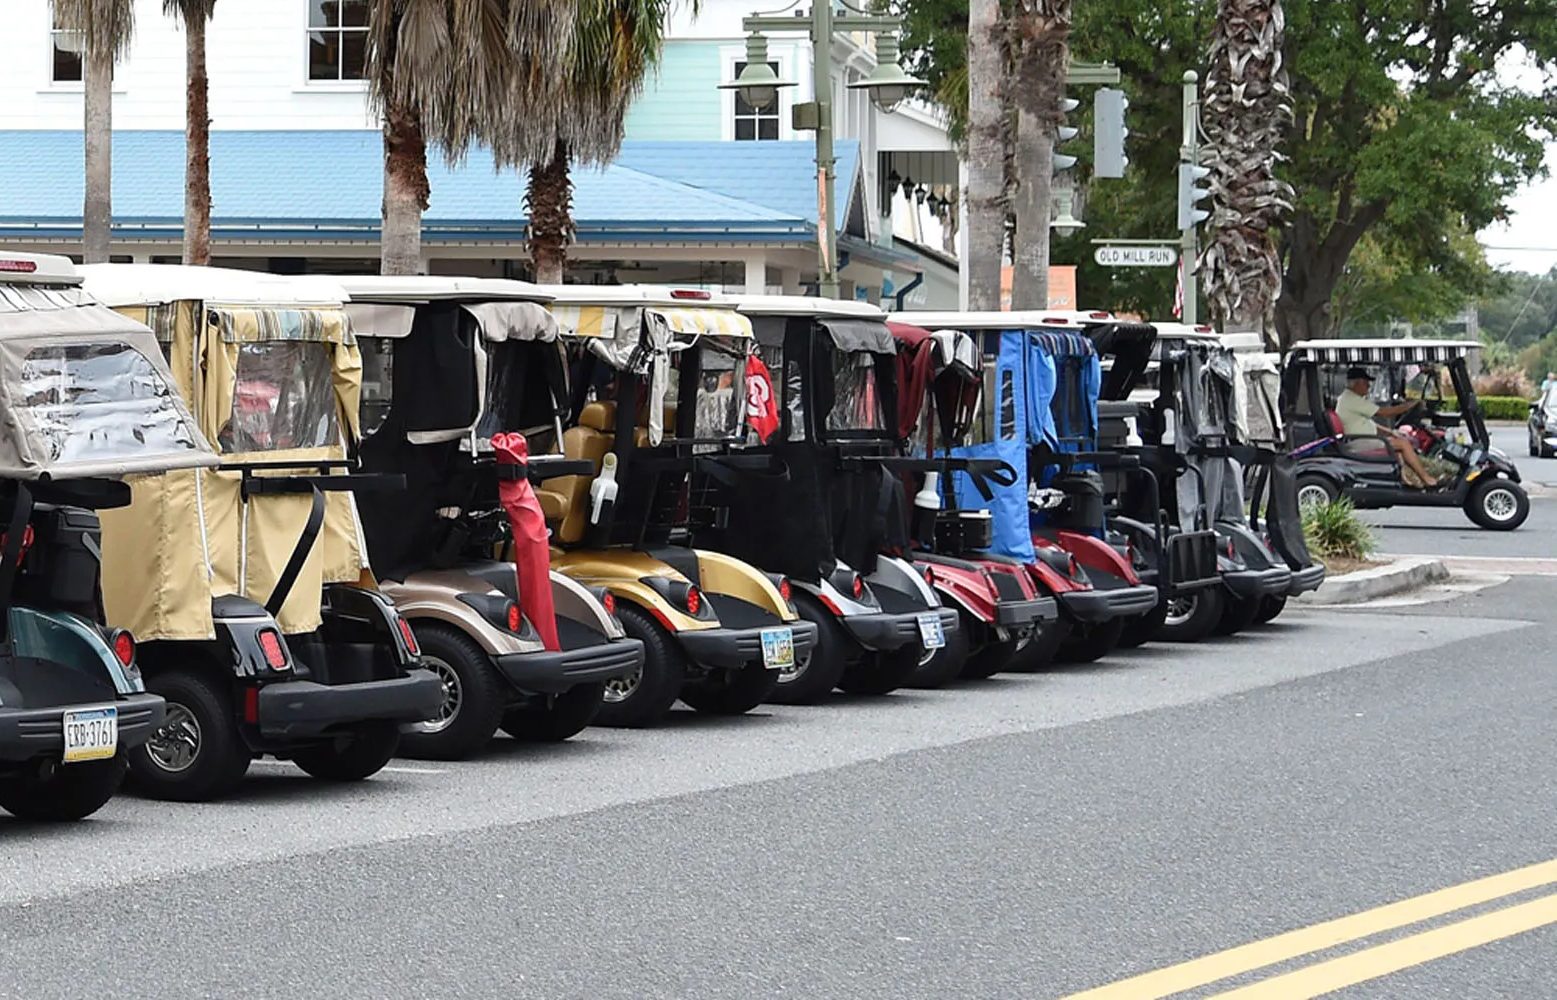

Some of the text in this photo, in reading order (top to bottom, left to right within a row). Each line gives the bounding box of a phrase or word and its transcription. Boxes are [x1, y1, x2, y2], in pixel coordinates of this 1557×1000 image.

[1100, 250, 1170, 262] OLD MILL RUN
